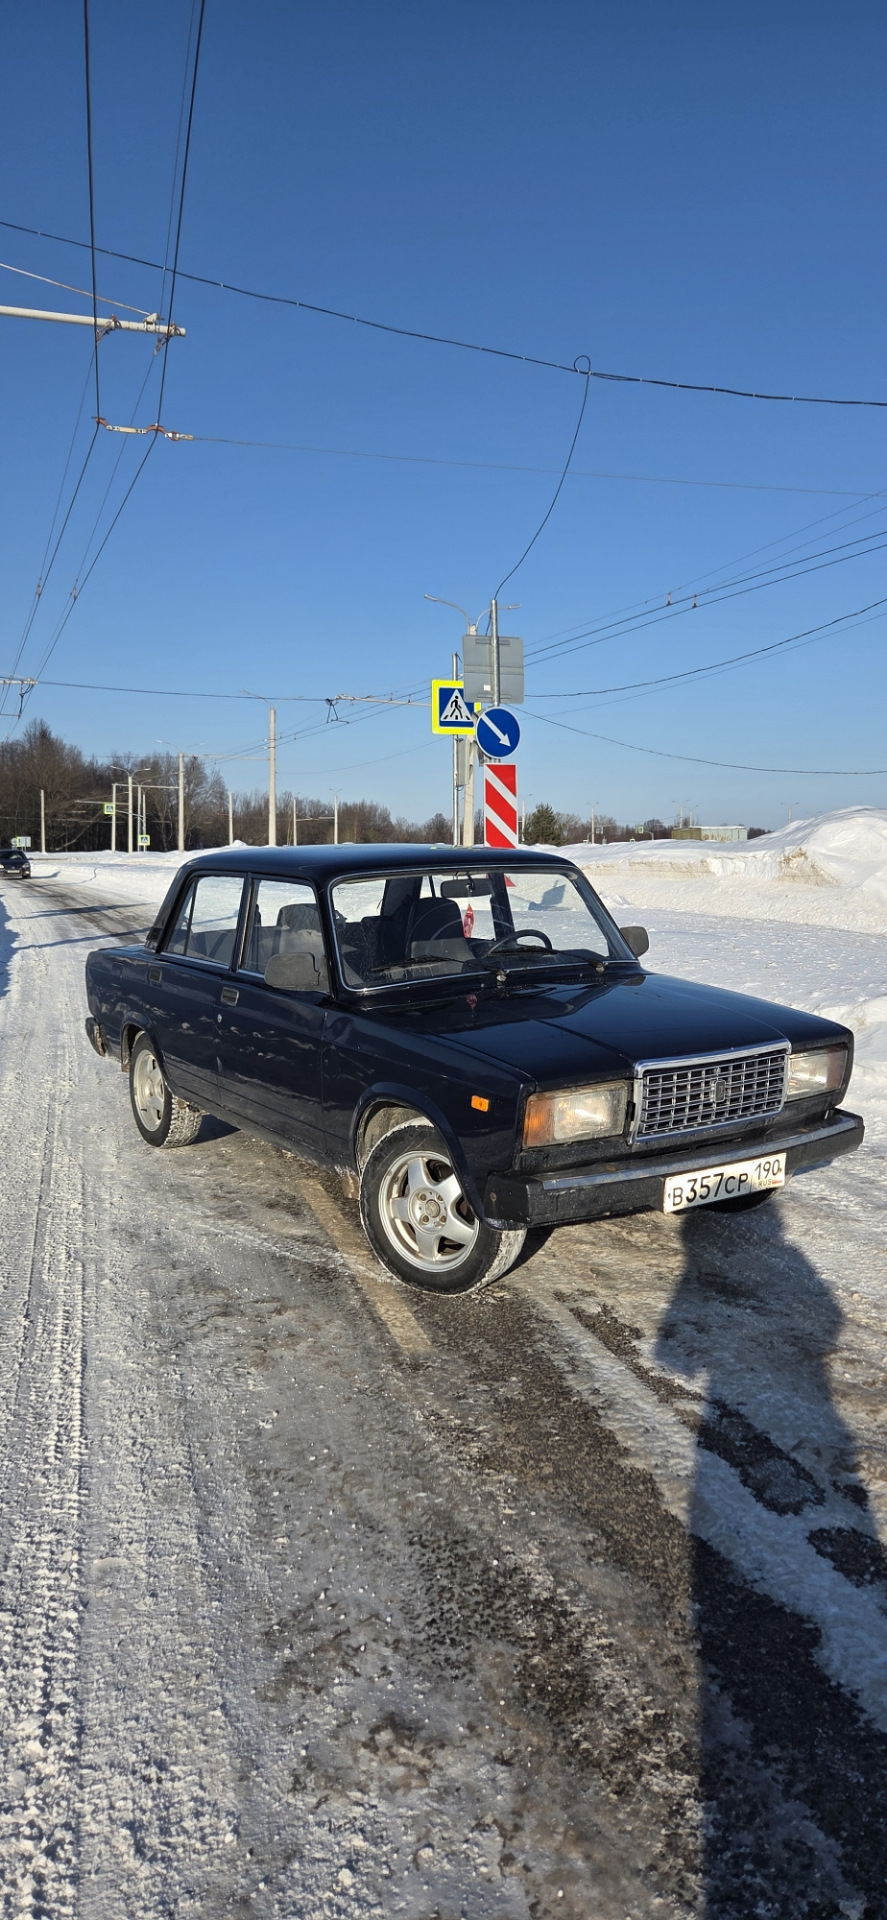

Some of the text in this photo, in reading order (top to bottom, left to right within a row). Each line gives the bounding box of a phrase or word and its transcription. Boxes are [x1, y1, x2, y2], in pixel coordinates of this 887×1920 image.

[672, 1159, 780, 1206] В357СР 190
[758, 1179, 772, 1187] RUS
